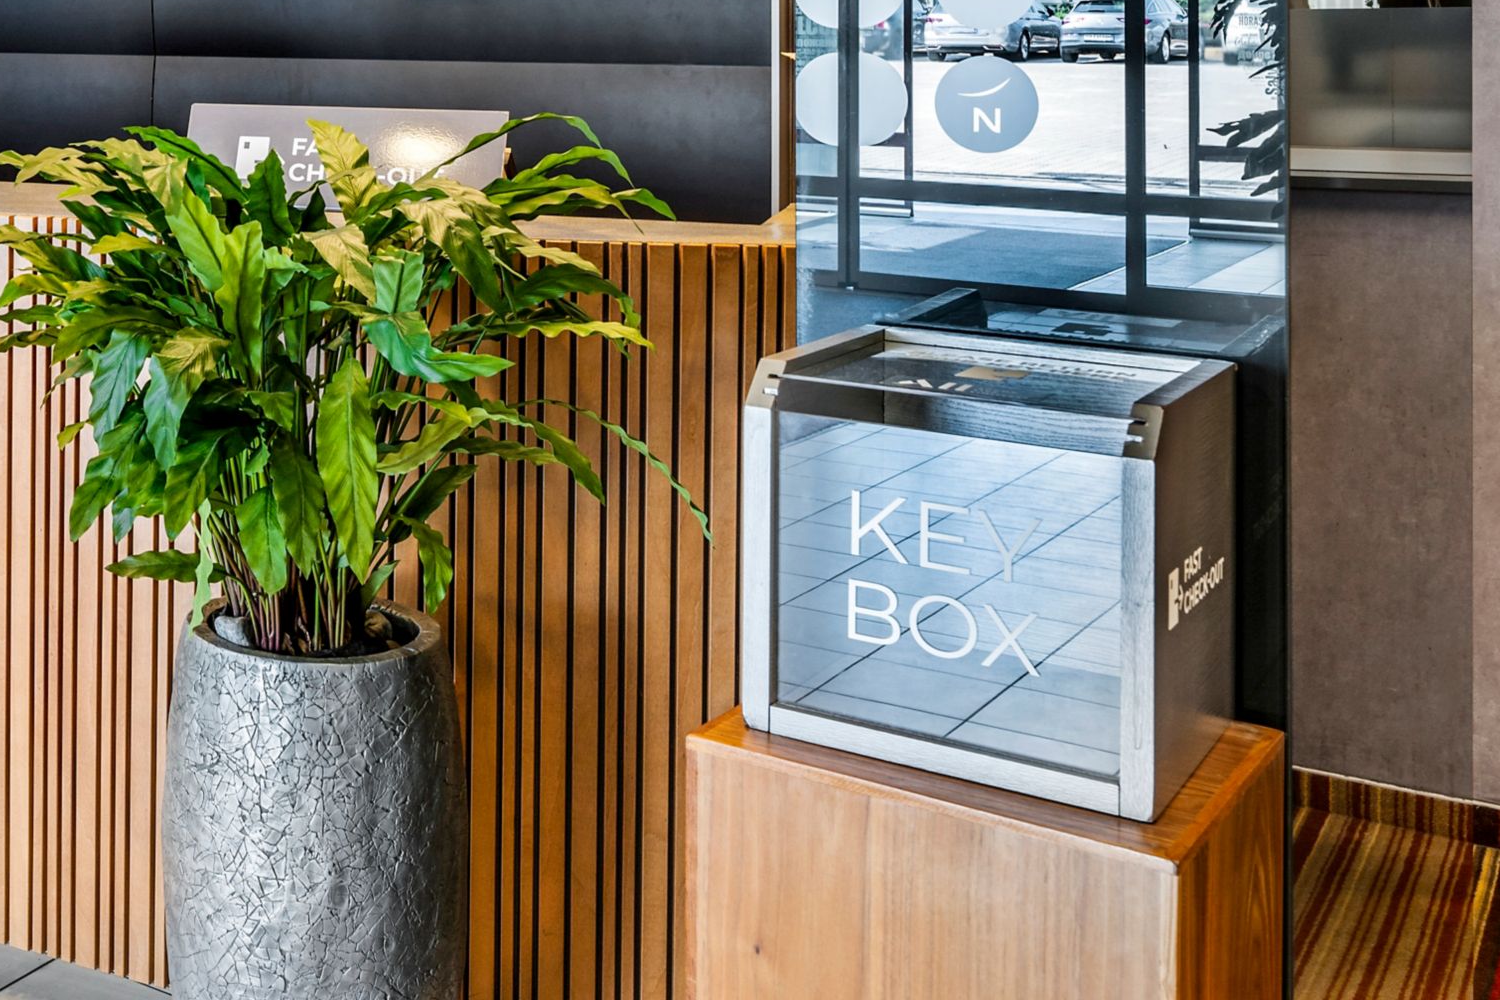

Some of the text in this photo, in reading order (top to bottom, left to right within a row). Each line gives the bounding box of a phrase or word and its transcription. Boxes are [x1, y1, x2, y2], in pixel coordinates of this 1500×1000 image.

[972, 107, 1001, 134] N
[851, 489, 1043, 583] KEY
[1184, 546, 1203, 583] FAST
[1184, 557, 1225, 614] CHECK-OUT
[847, 578, 1041, 678] BOX
